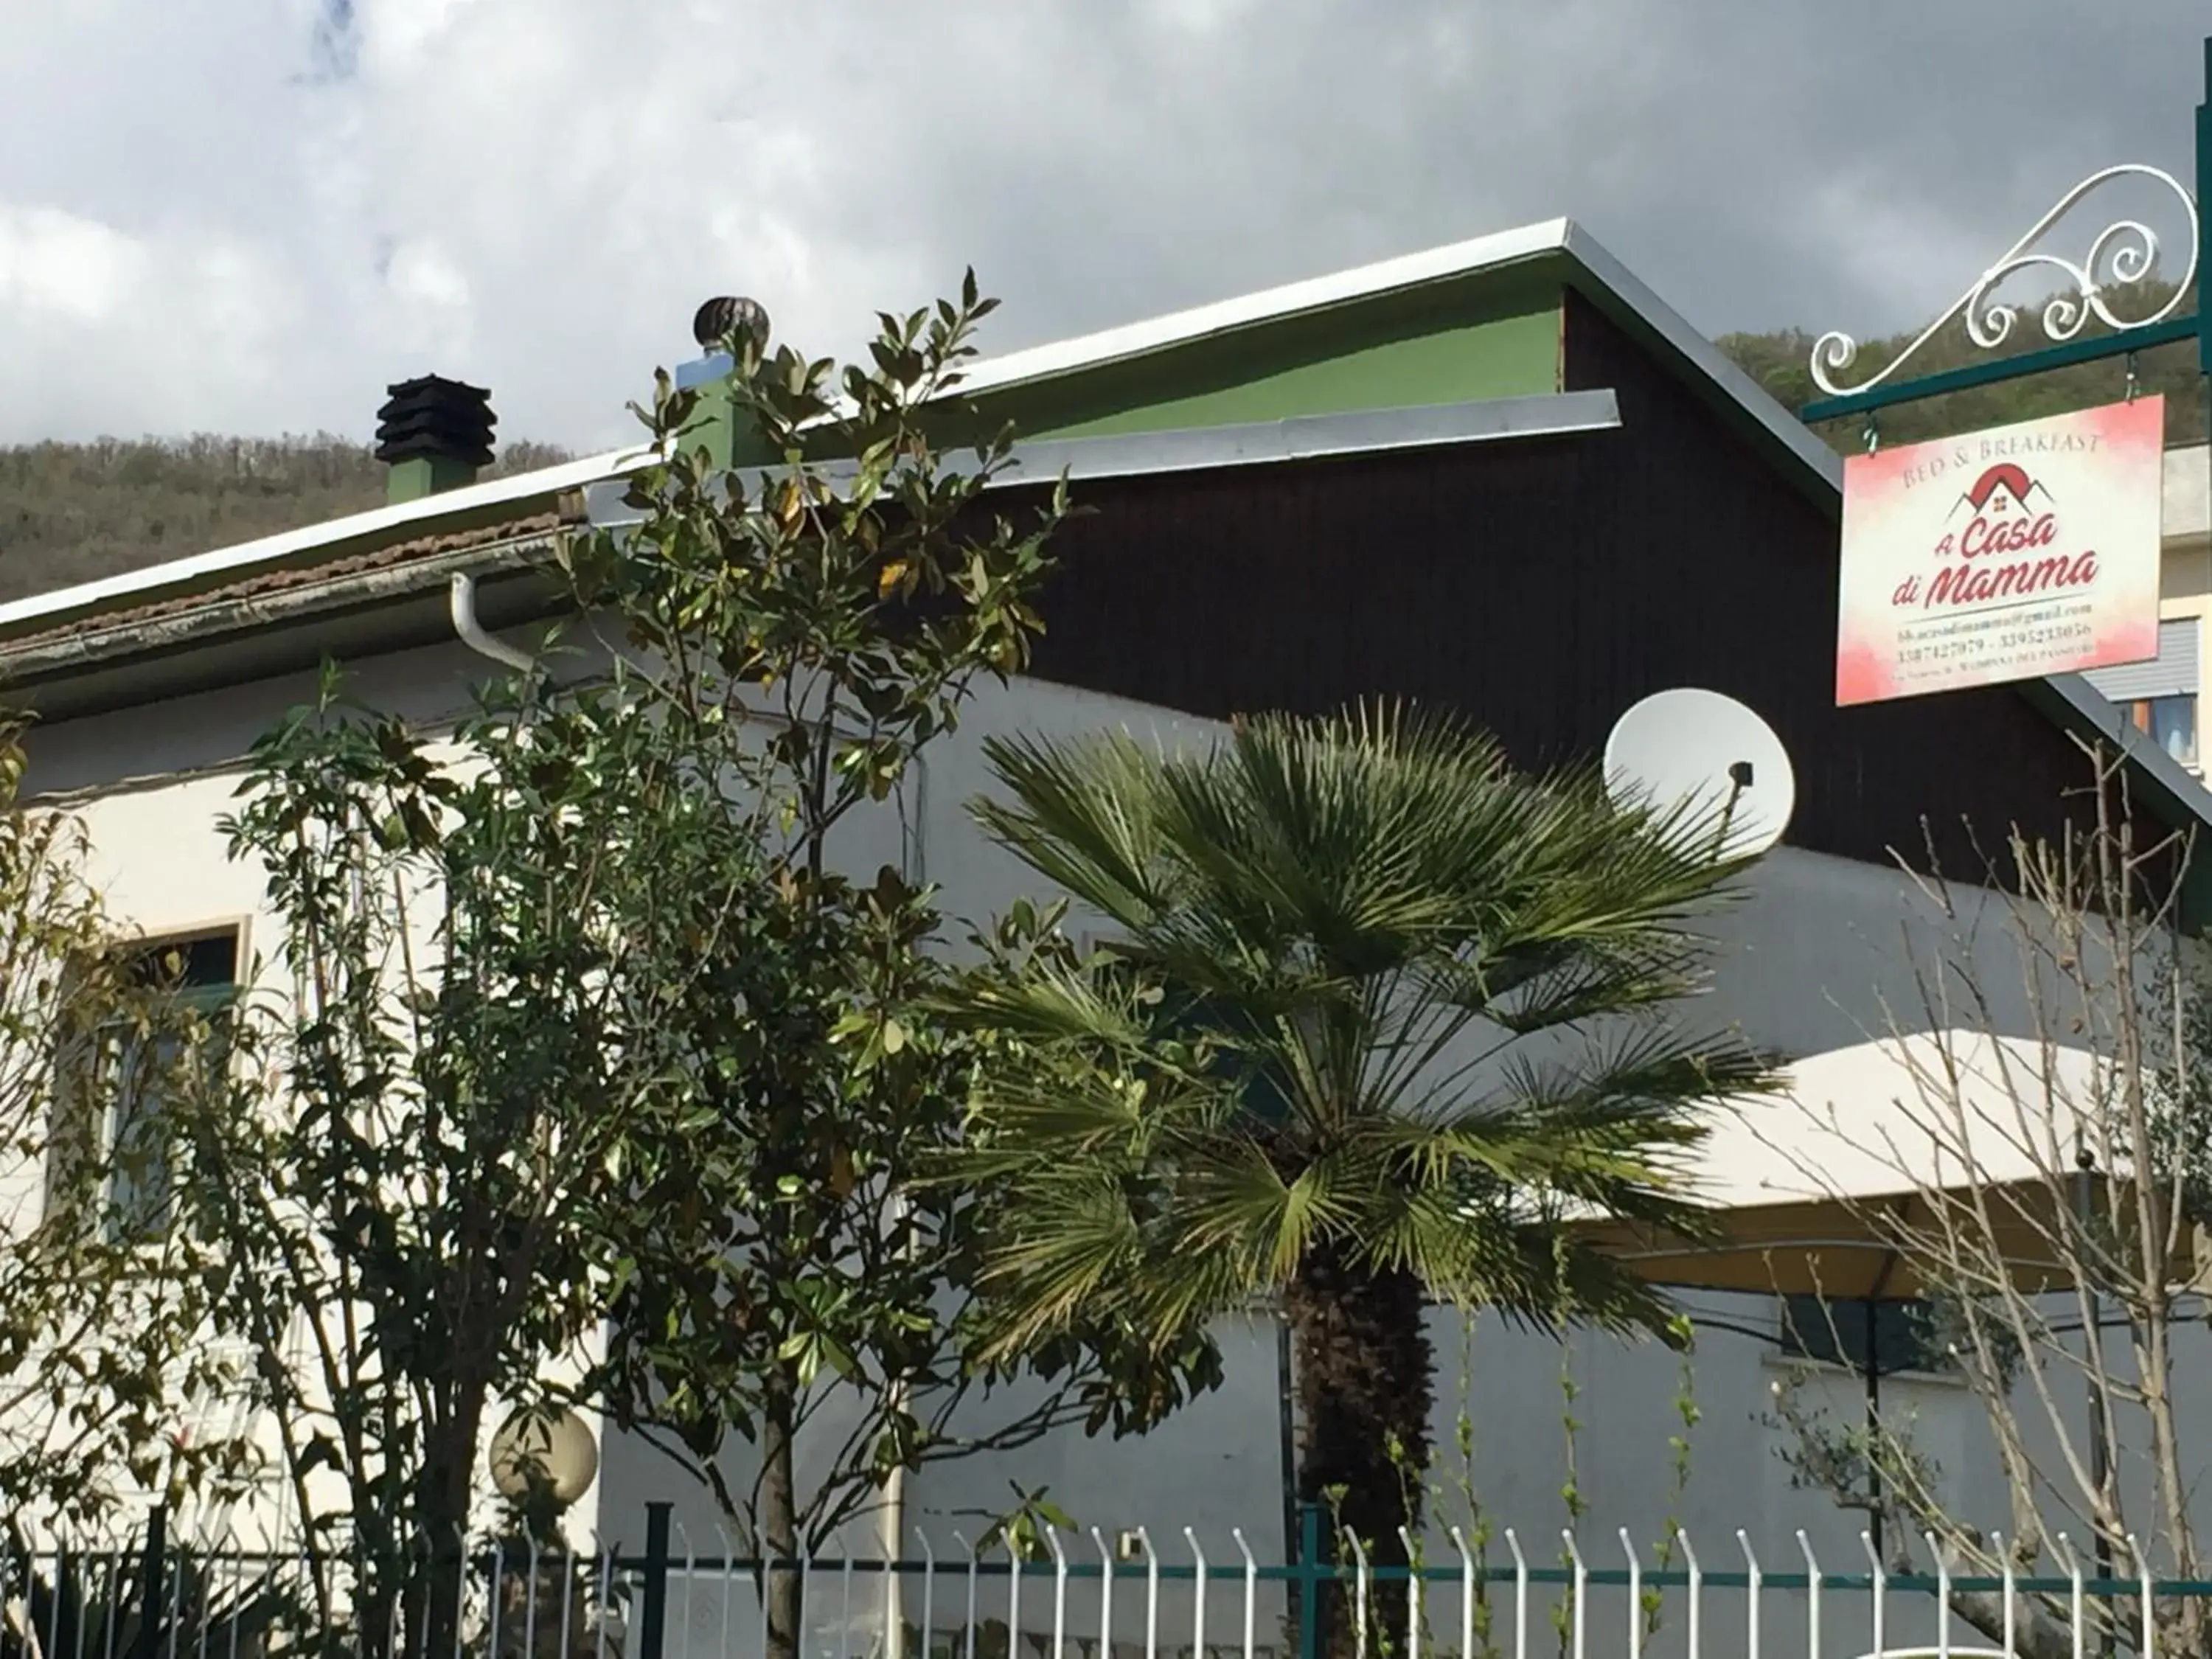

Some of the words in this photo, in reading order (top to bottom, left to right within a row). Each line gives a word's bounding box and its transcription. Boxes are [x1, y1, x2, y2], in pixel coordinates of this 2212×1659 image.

[1903, 457, 1946, 490] BED
[1953, 446, 1969, 469] &
[1980, 432, 2103, 461] BREAKFAST
[1961, 512, 2059, 559] Casa
[1891, 574, 1922, 606] di
[1924, 550, 2099, 609] Mamma
